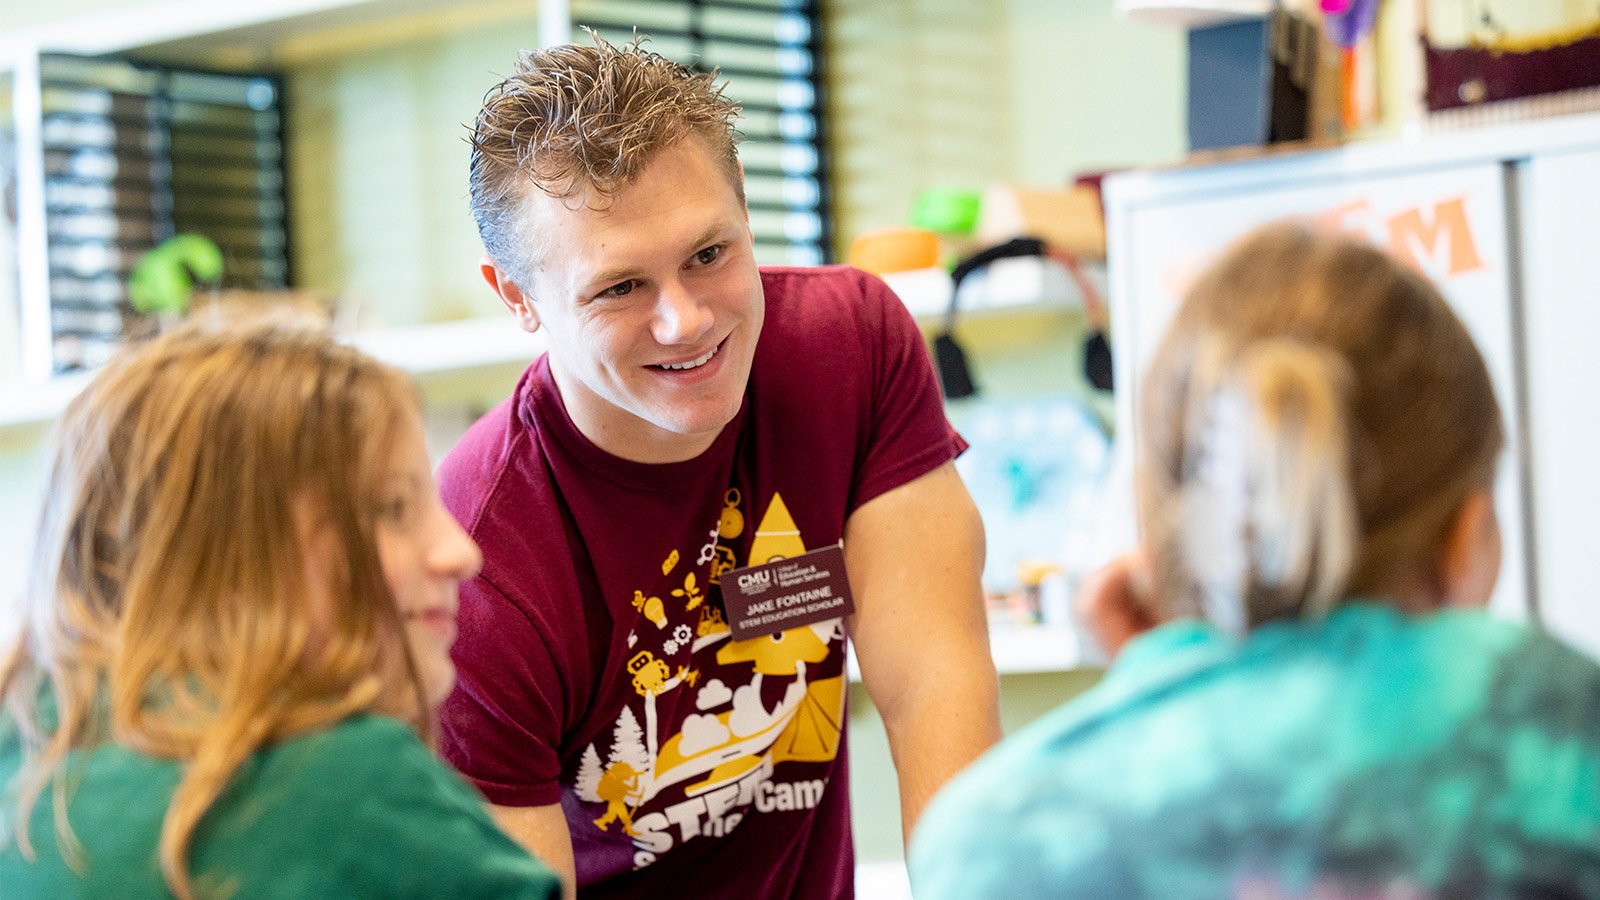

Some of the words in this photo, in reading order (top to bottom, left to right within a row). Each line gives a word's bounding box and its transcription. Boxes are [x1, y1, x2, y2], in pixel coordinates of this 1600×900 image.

[738, 570, 770, 588] CMU
[738, 617, 761, 630] STEM
[761, 606, 807, 624] EDUCATION
[806, 596, 845, 613] SCHOLAR
[746, 599, 775, 616] JAKE
[776, 585, 833, 609] FONTAINE
[754, 779, 829, 813] Cam
